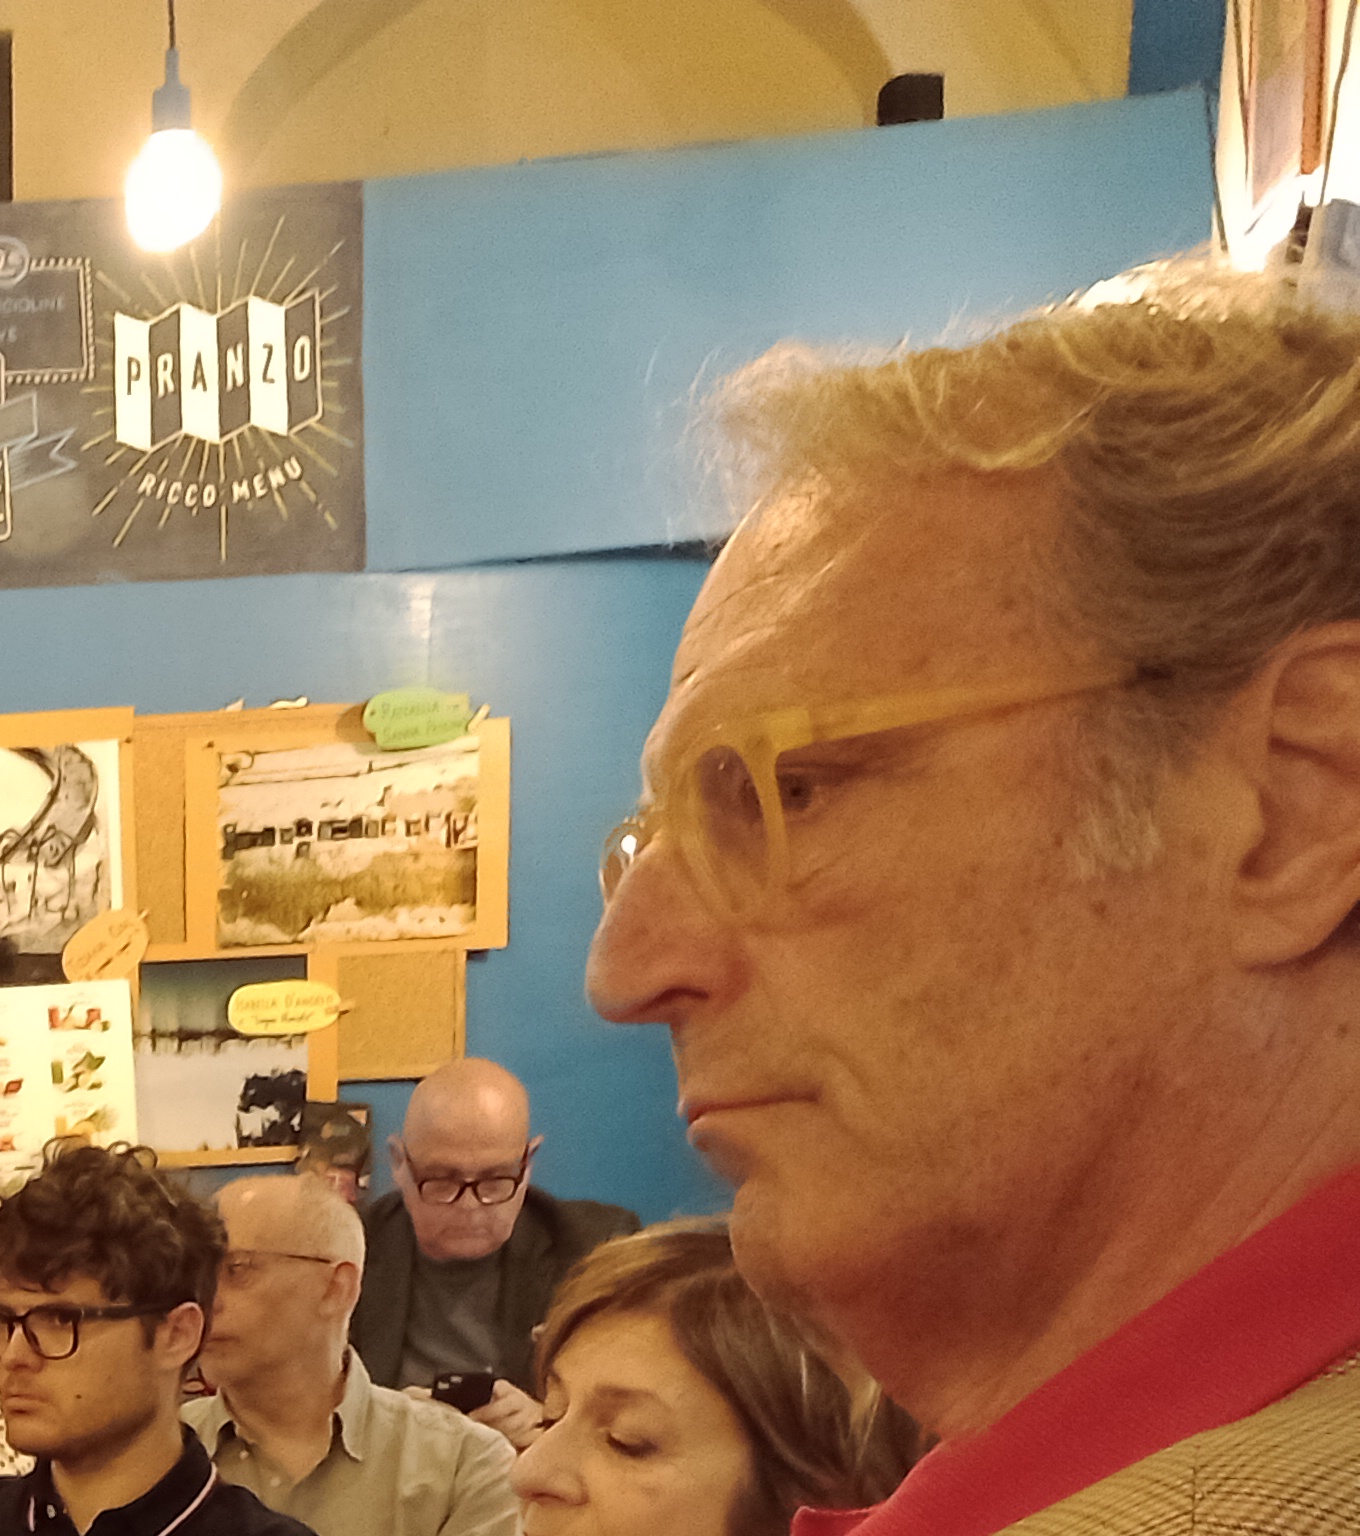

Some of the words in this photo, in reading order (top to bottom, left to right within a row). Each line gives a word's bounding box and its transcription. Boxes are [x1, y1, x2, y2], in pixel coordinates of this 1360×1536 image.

[126, 335, 311, 398] PRANZO
[138, 472, 218, 508] RICCO
[231, 456, 303, 503] MENU
